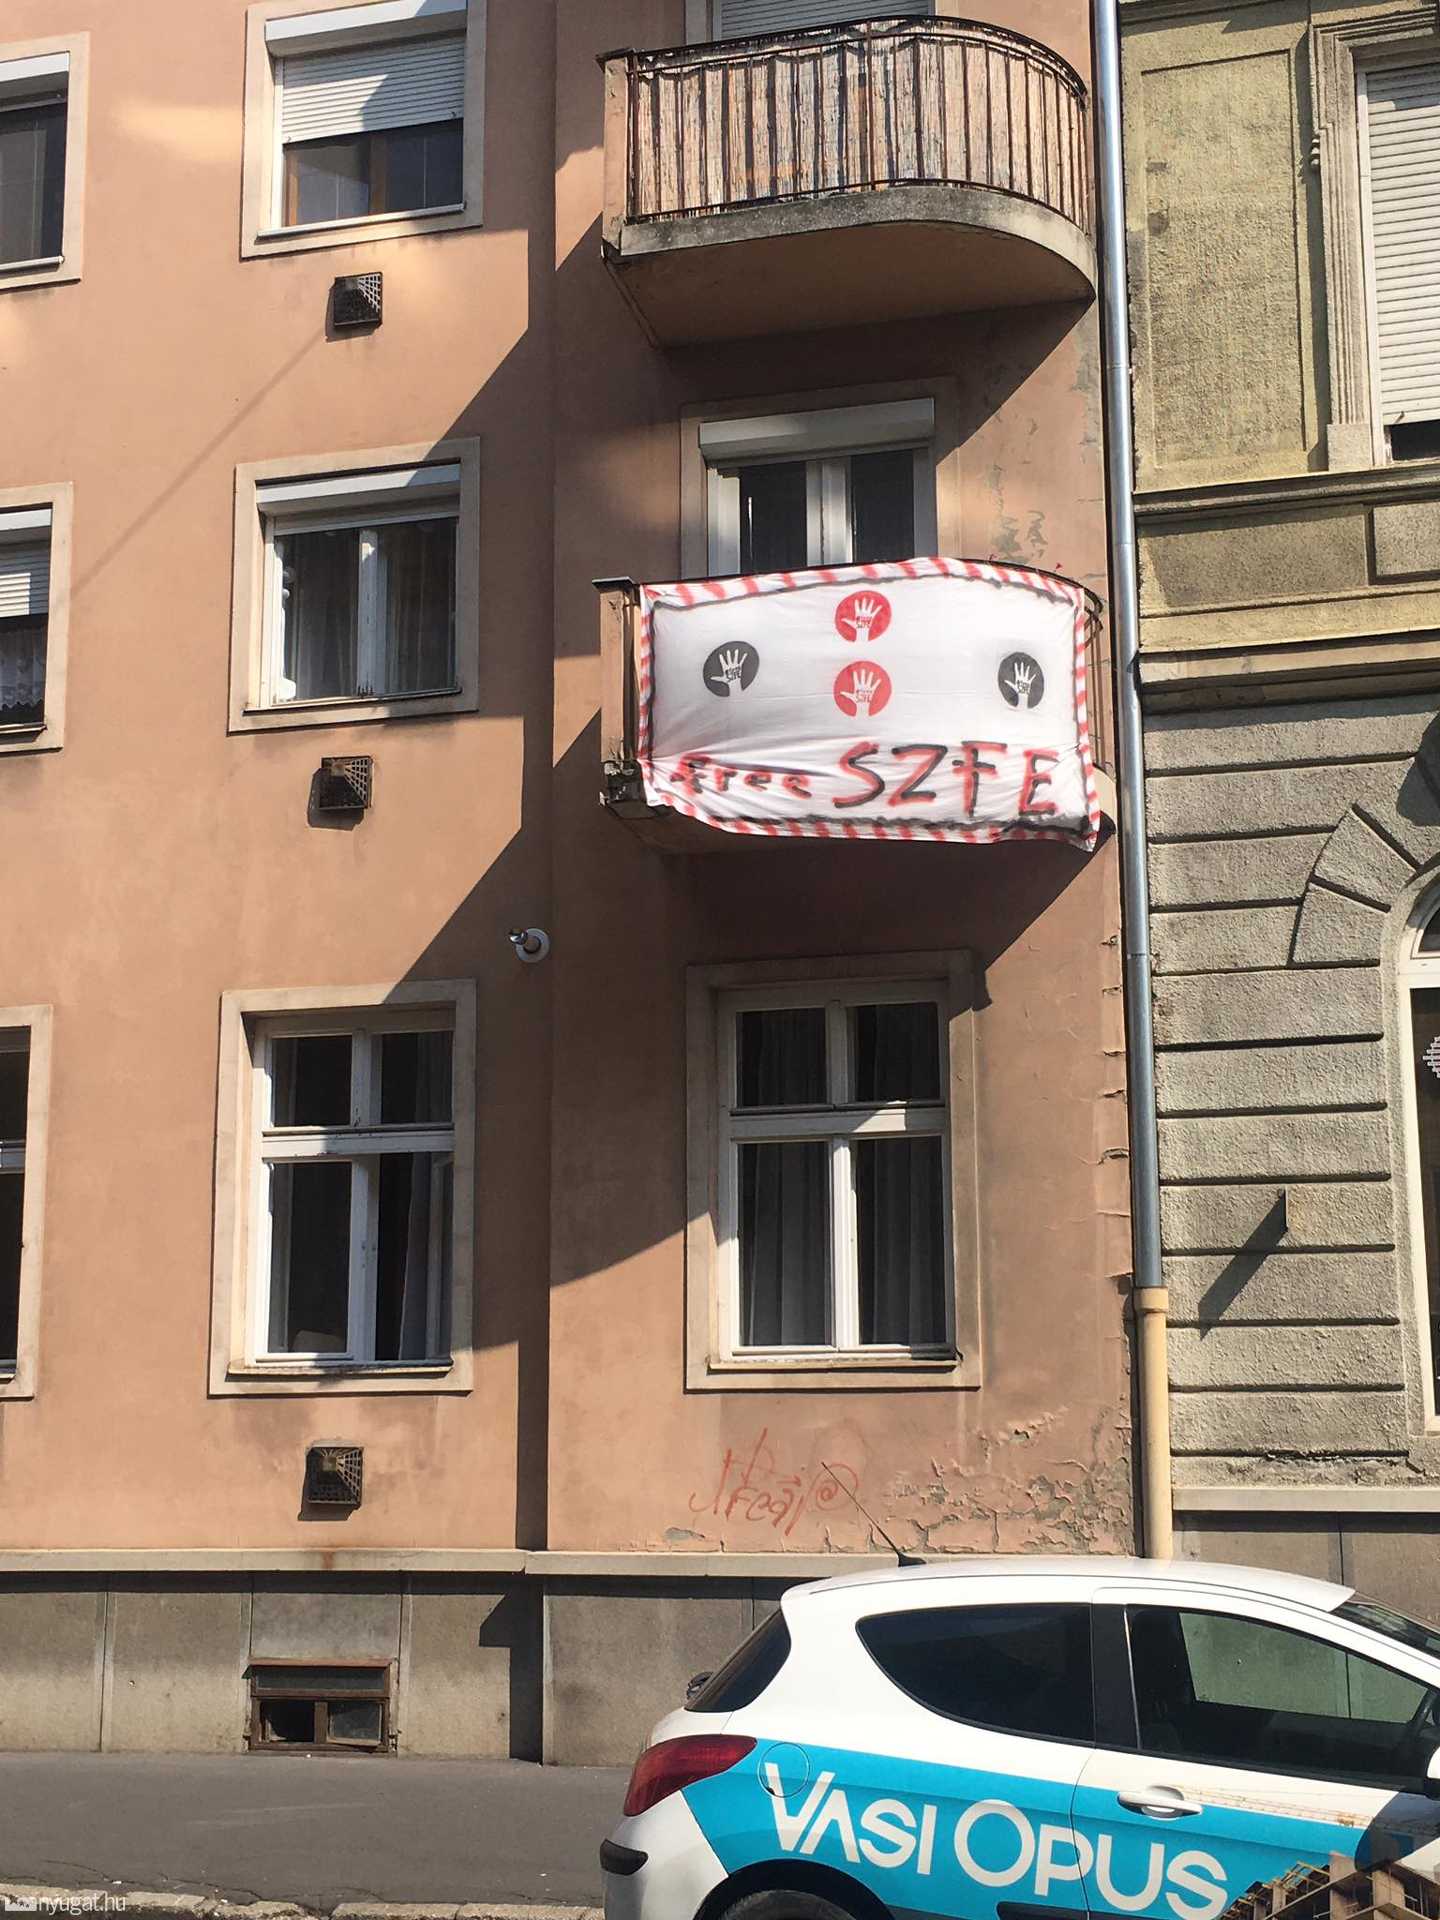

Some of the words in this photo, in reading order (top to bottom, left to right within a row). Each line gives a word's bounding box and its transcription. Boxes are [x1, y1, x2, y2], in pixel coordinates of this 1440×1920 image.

[831, 741, 1059, 818] SZFE
[765, 1762, 937, 1875] VASI
[954, 1799, 1228, 1920] OPUS
